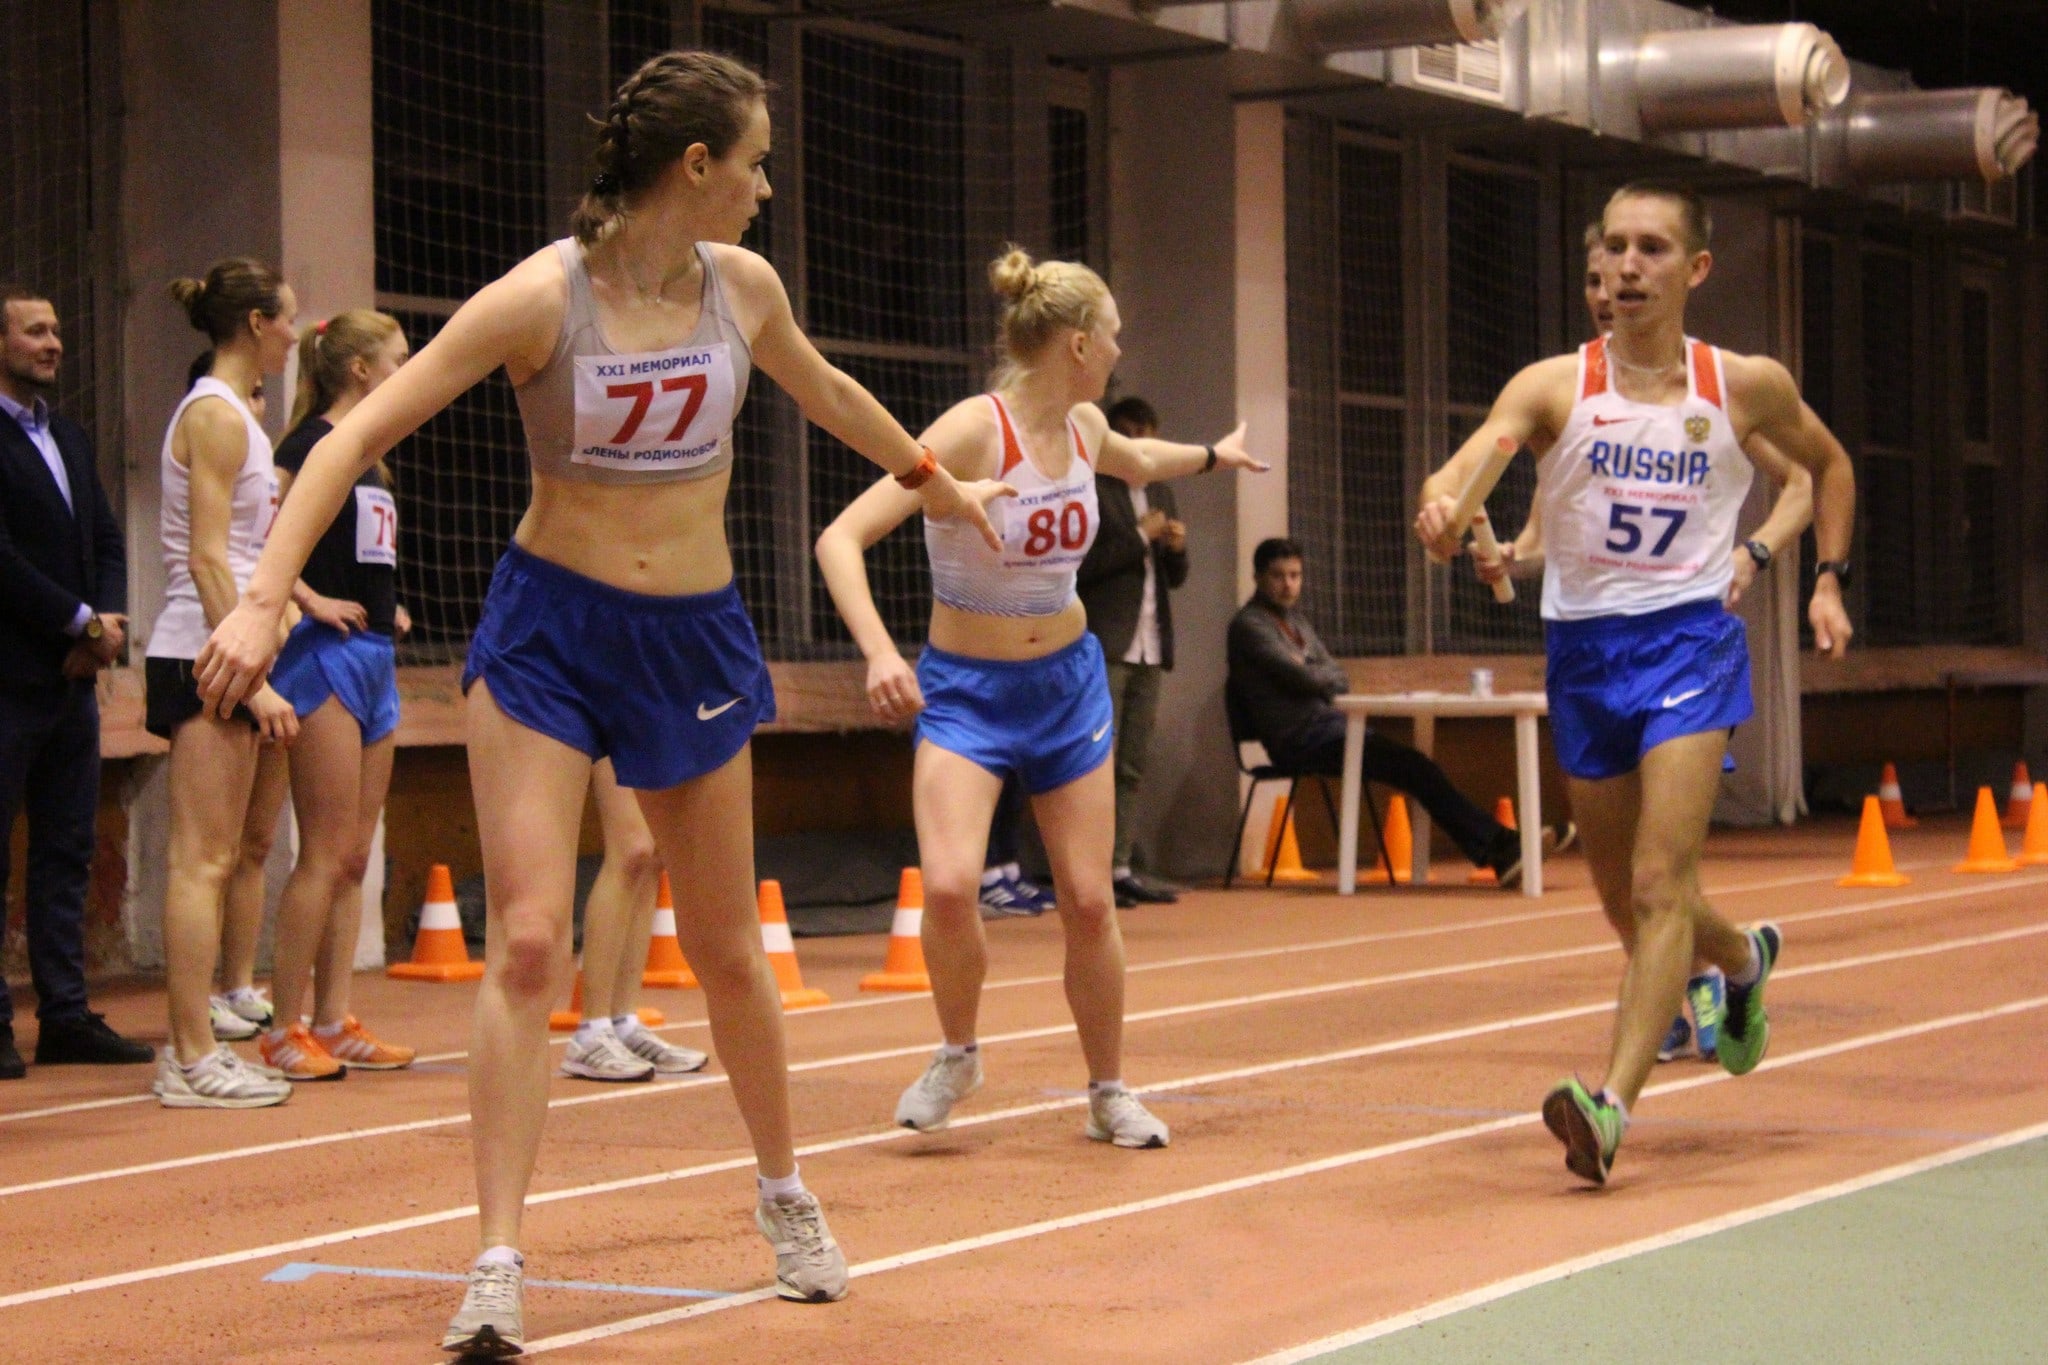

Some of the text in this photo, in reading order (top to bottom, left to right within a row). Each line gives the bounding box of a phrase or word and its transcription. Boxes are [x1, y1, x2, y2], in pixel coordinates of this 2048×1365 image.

[597, 353, 712, 377] XXI МЕМОРИАЛ
[607, 374, 709, 445] 77
[1587, 441, 1711, 485] RUSSIA
[1025, 501, 1087, 557] 80
[1605, 503, 1687, 557] 57
